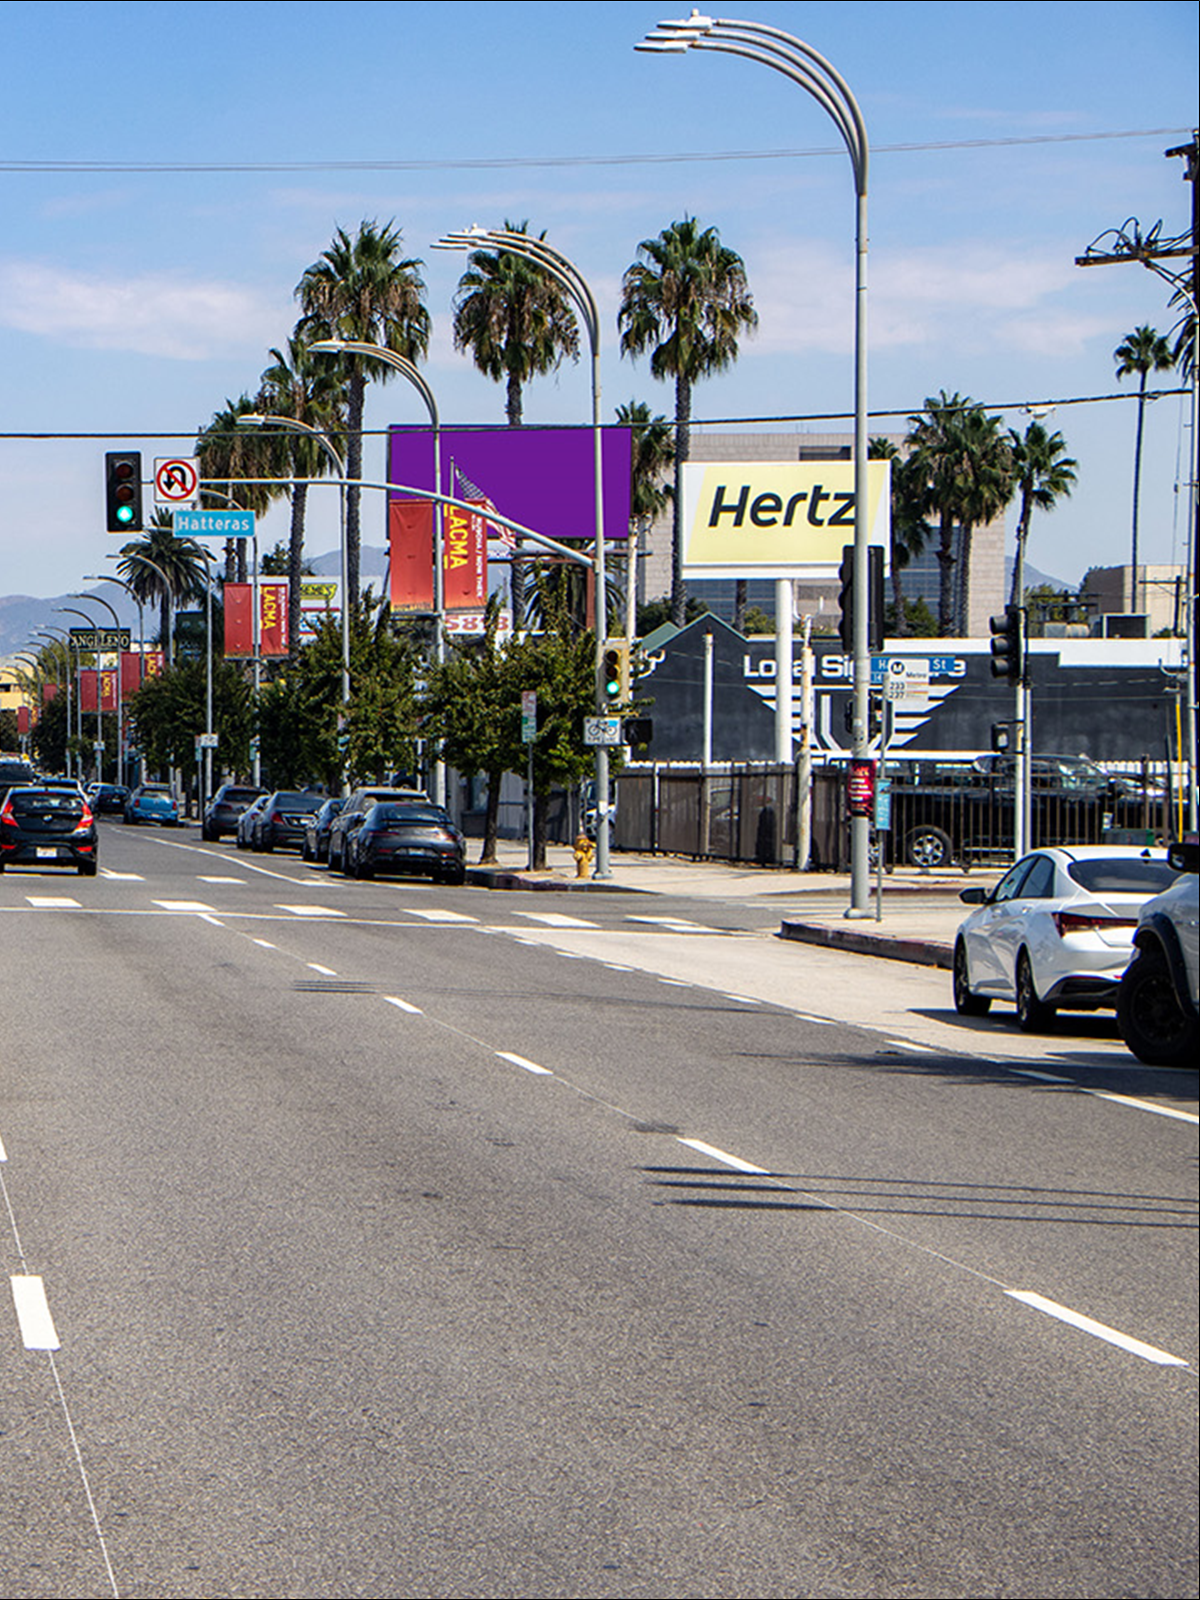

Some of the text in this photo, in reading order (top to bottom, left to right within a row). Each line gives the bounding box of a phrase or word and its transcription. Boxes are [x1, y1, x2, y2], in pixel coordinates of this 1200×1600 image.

[708, 485, 856, 527] Hertz
[177, 514, 250, 532] Hatteras
[448, 503, 469, 569] LACMA
[263, 586, 277, 630] LACMA
[743, 654, 817, 679] Loal
[933, 659, 947, 670] St
